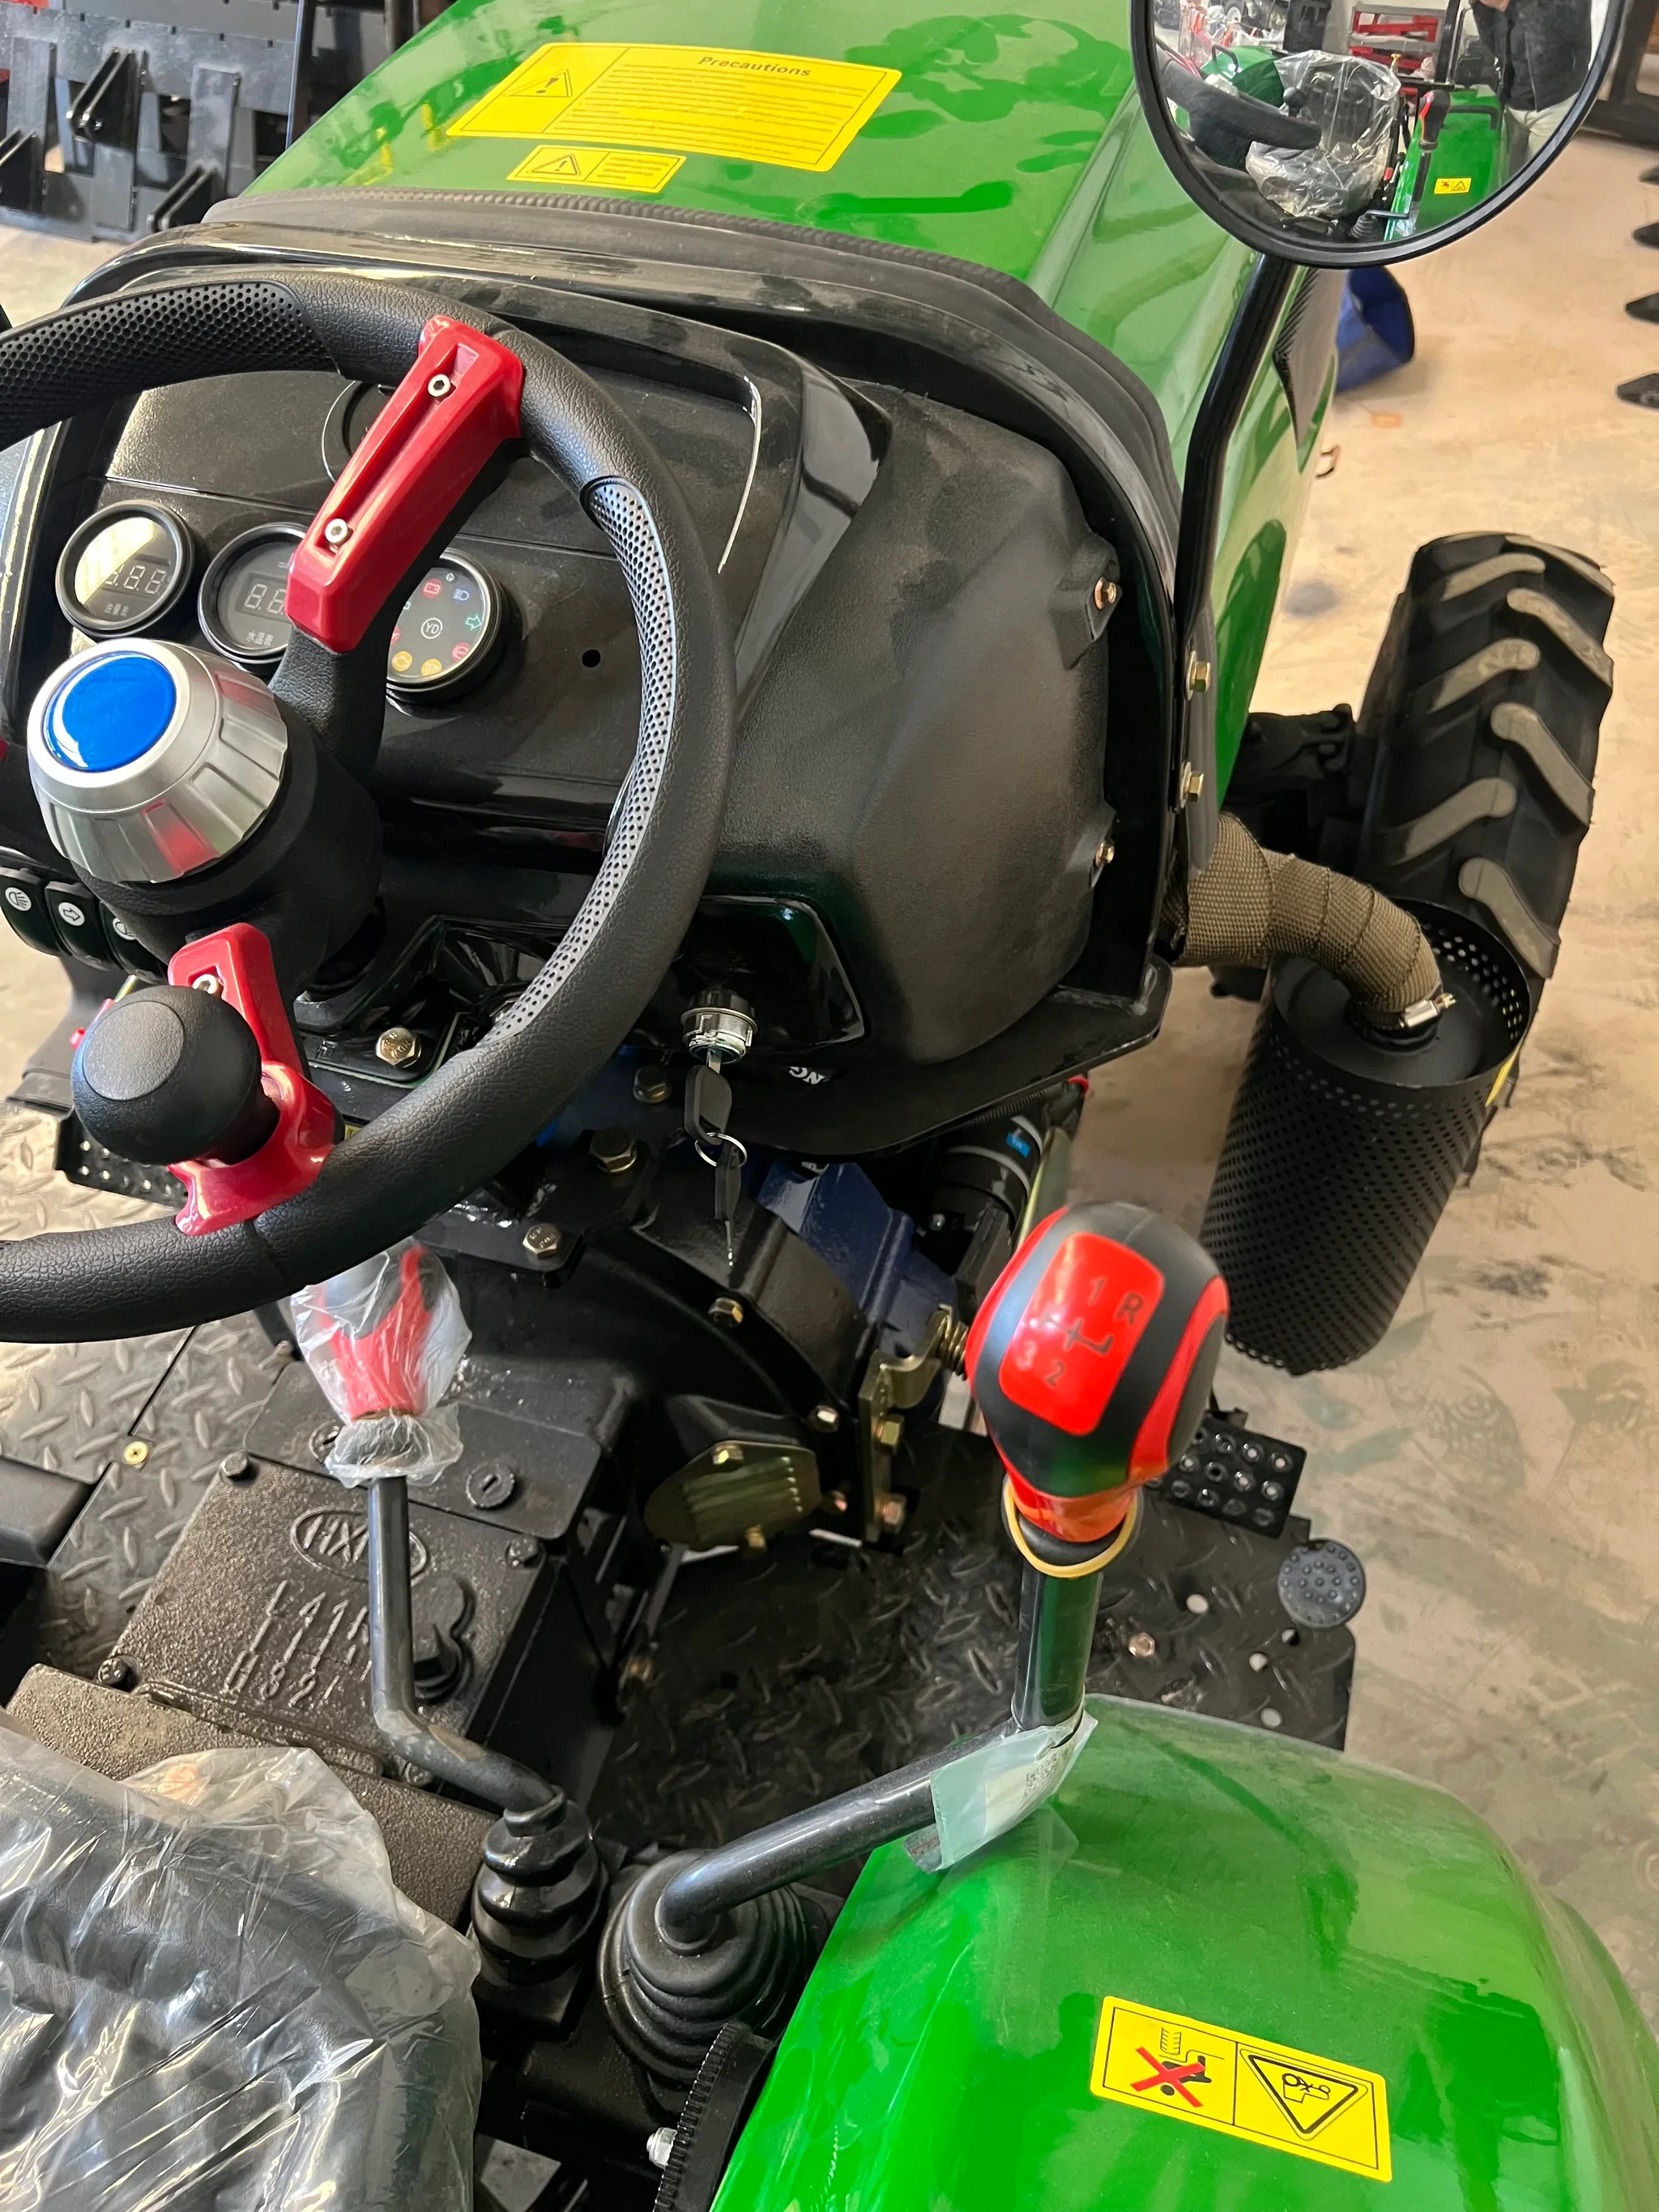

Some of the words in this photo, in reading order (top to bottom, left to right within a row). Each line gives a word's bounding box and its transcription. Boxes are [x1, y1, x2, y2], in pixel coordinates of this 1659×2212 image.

[698, 57, 811, 77] Precautions
[245, 629, 275, 646] 水温表
[425, 621, 440, 635] YD
[1088, 1275, 1107, 1306] 1
[1113, 1291, 1145, 1325] R
[1017, 1340, 1037, 1370] 3
[1046, 1360, 1066, 1387] 2
